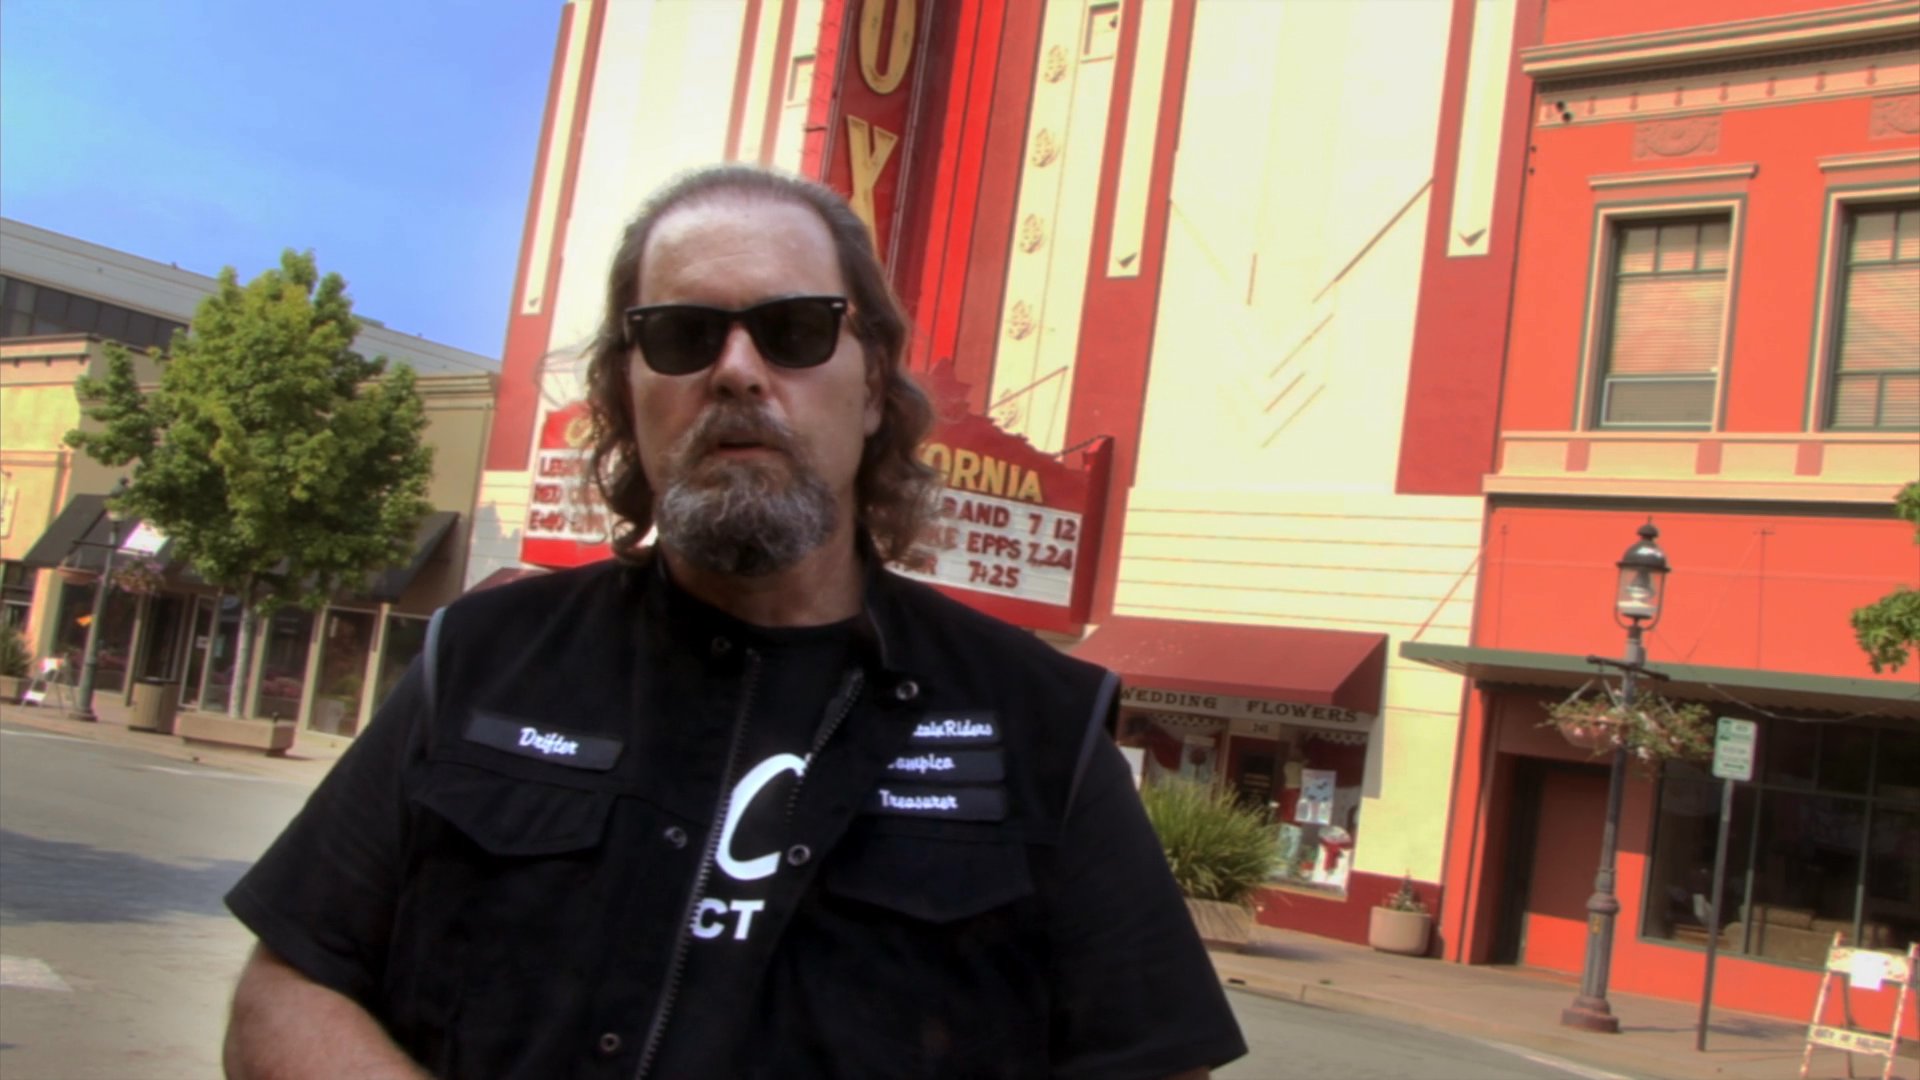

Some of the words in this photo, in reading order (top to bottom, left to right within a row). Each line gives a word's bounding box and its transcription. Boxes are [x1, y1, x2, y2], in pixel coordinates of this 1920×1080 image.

[1028, 512, 1043, 536] 7
[1053, 517, 1077, 542] 12
[967, 530, 1022, 560] EPPS
[1120, 686, 1218, 710] WEDDING
[1246, 700, 1358, 724] FLOWERS
[878, 788, 959, 811] Treasurer
